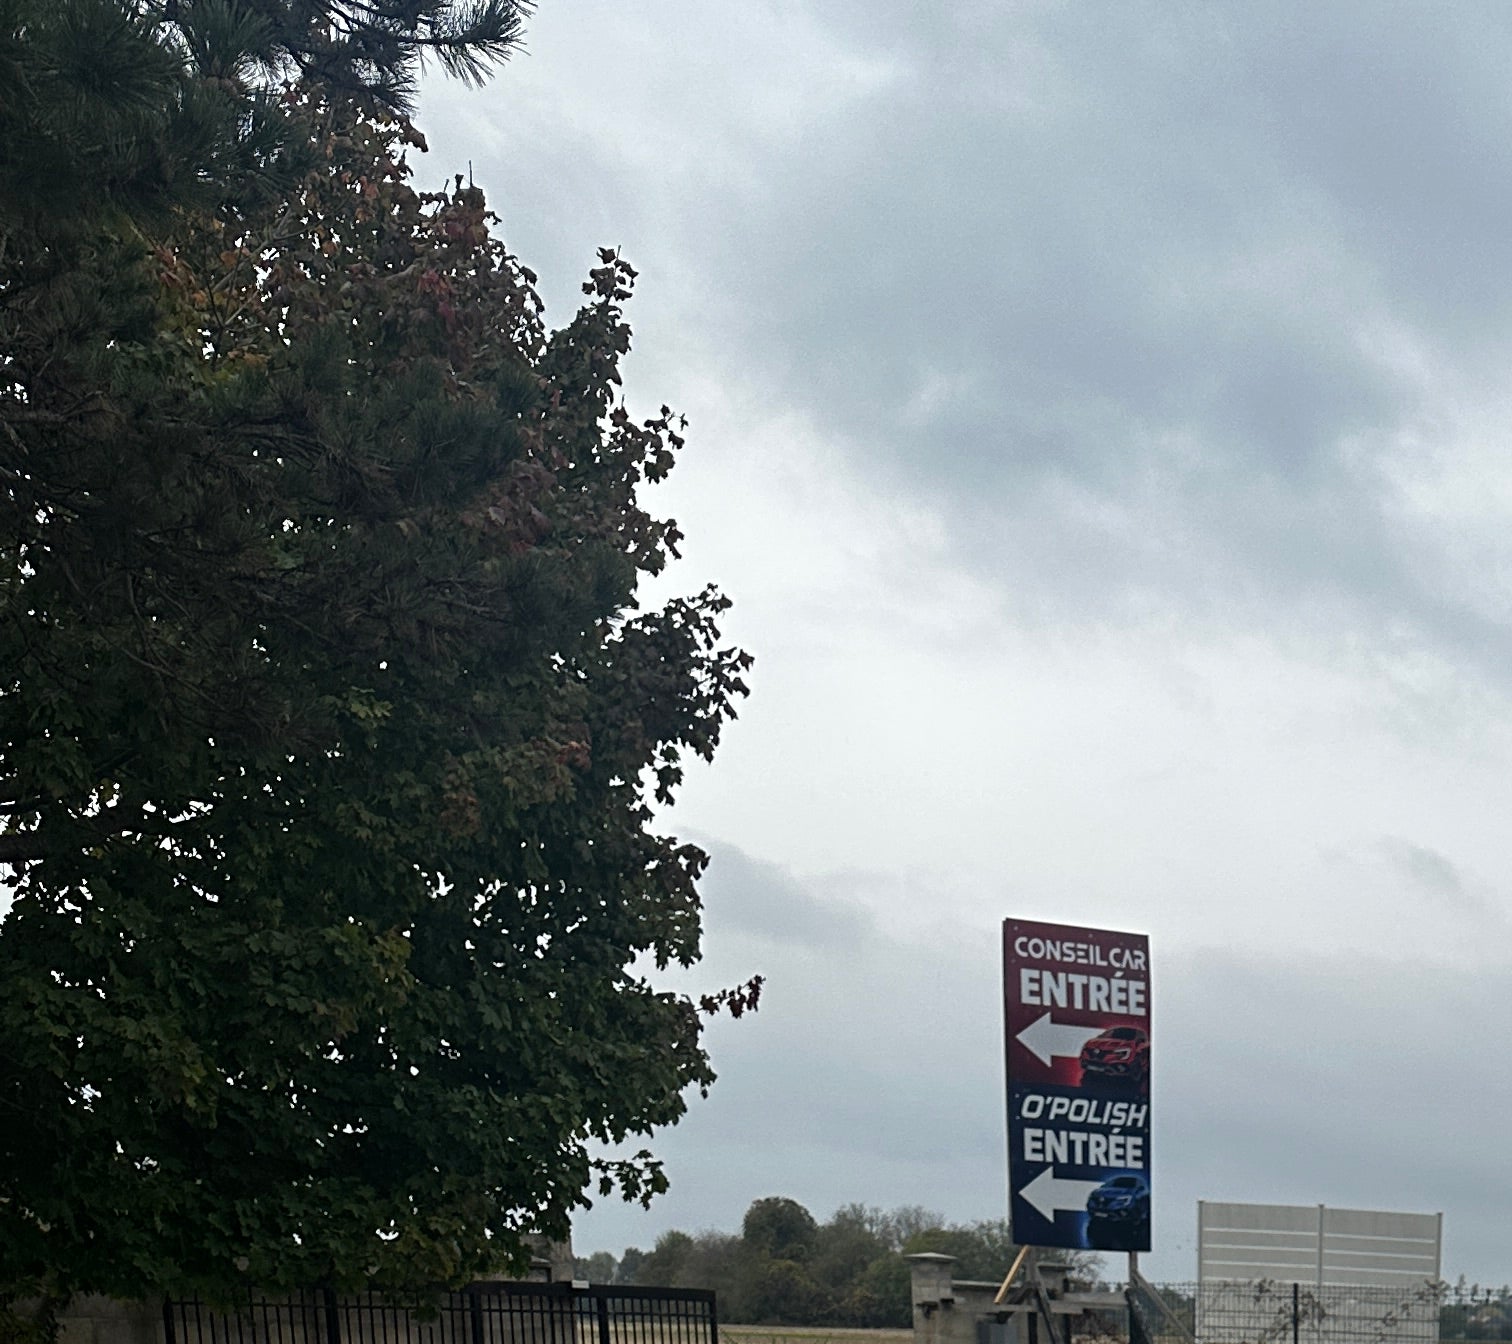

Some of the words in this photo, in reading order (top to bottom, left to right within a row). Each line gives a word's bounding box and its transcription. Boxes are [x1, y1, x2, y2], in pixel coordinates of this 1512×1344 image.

[1014, 936, 1108, 966] CONSEIL
[1109, 948, 1146, 971] CAR
[1020, 969, 1146, 1016] ENTRÉE
[1021, 1094, 1148, 1127] O'POLISH
[1023, 1127, 1144, 1169] ENTRÉE
